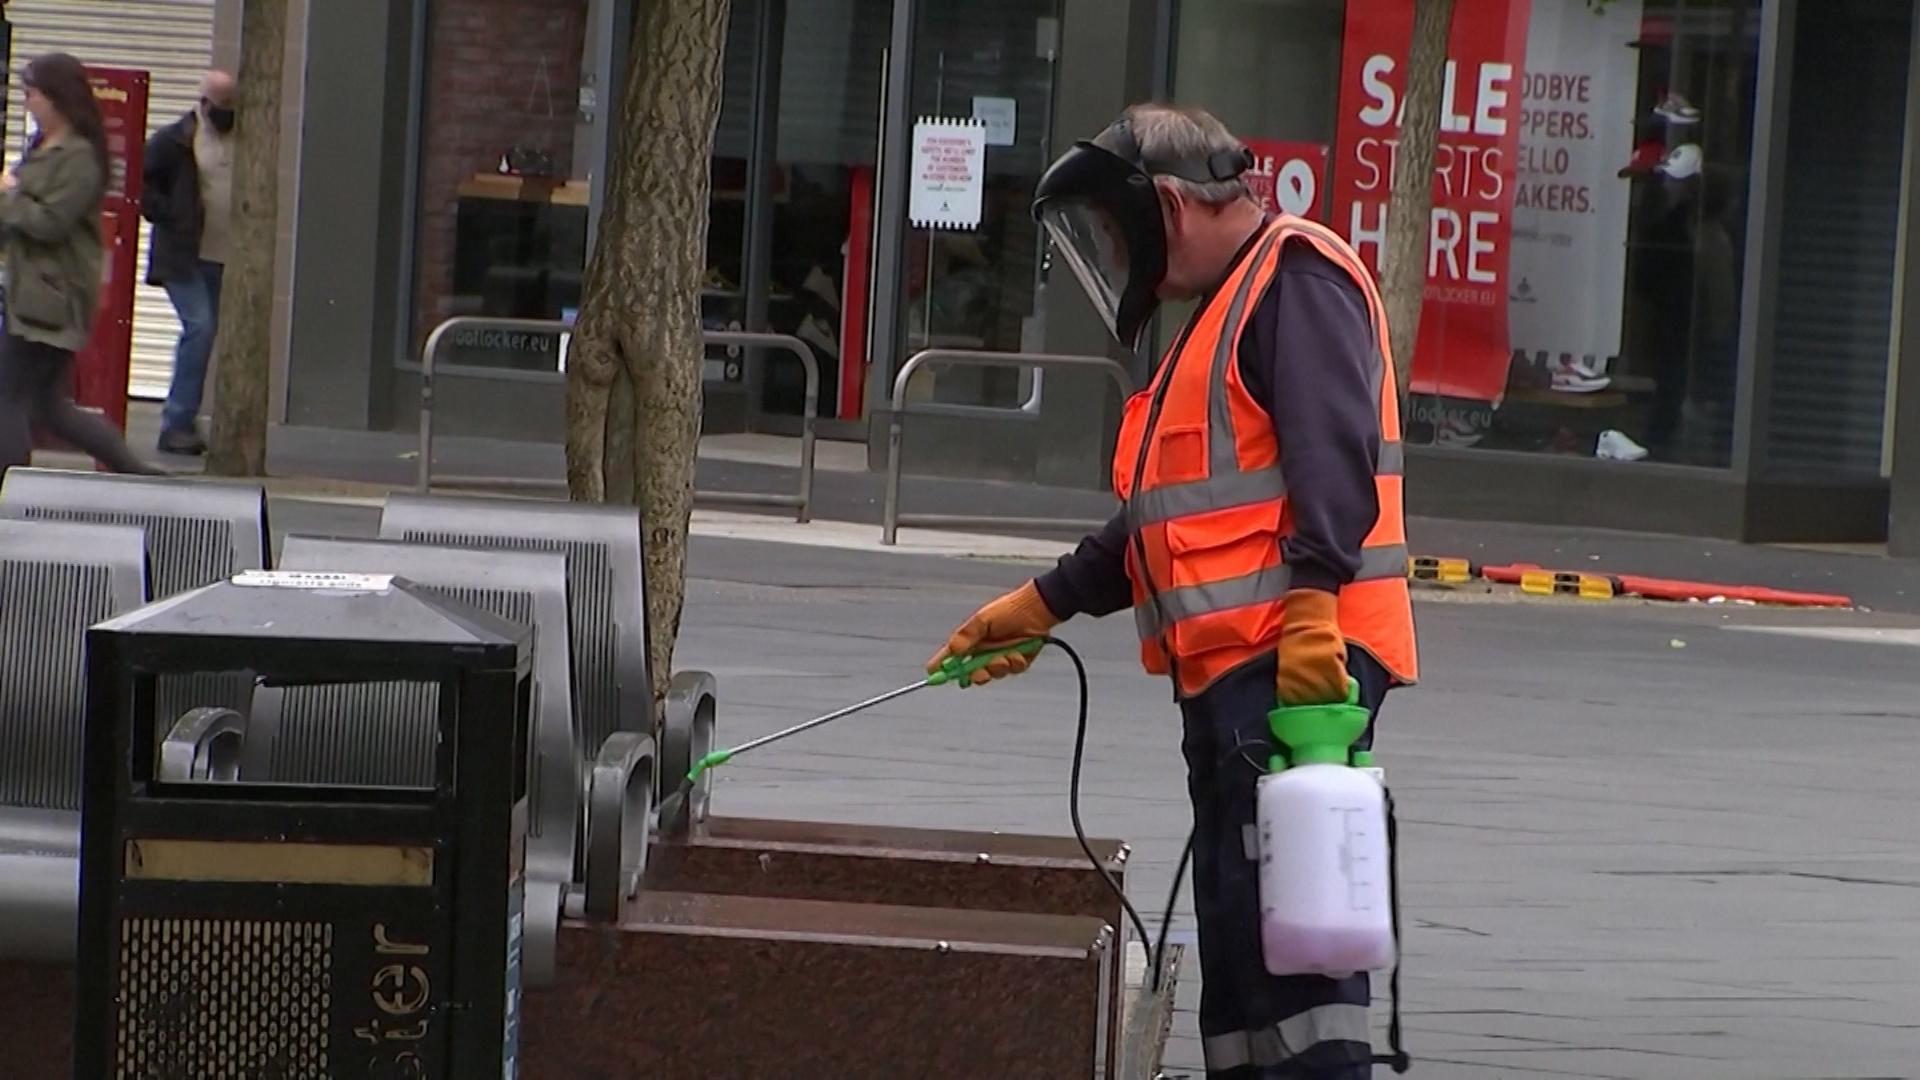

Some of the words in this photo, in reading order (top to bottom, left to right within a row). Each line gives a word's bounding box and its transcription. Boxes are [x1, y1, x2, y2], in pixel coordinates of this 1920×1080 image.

[1359, 54, 1513, 135] SLE
[1247, 154, 1274, 176] LE
[1356, 137, 1503, 200] STRTS
[1350, 201, 1500, 282] HRE
